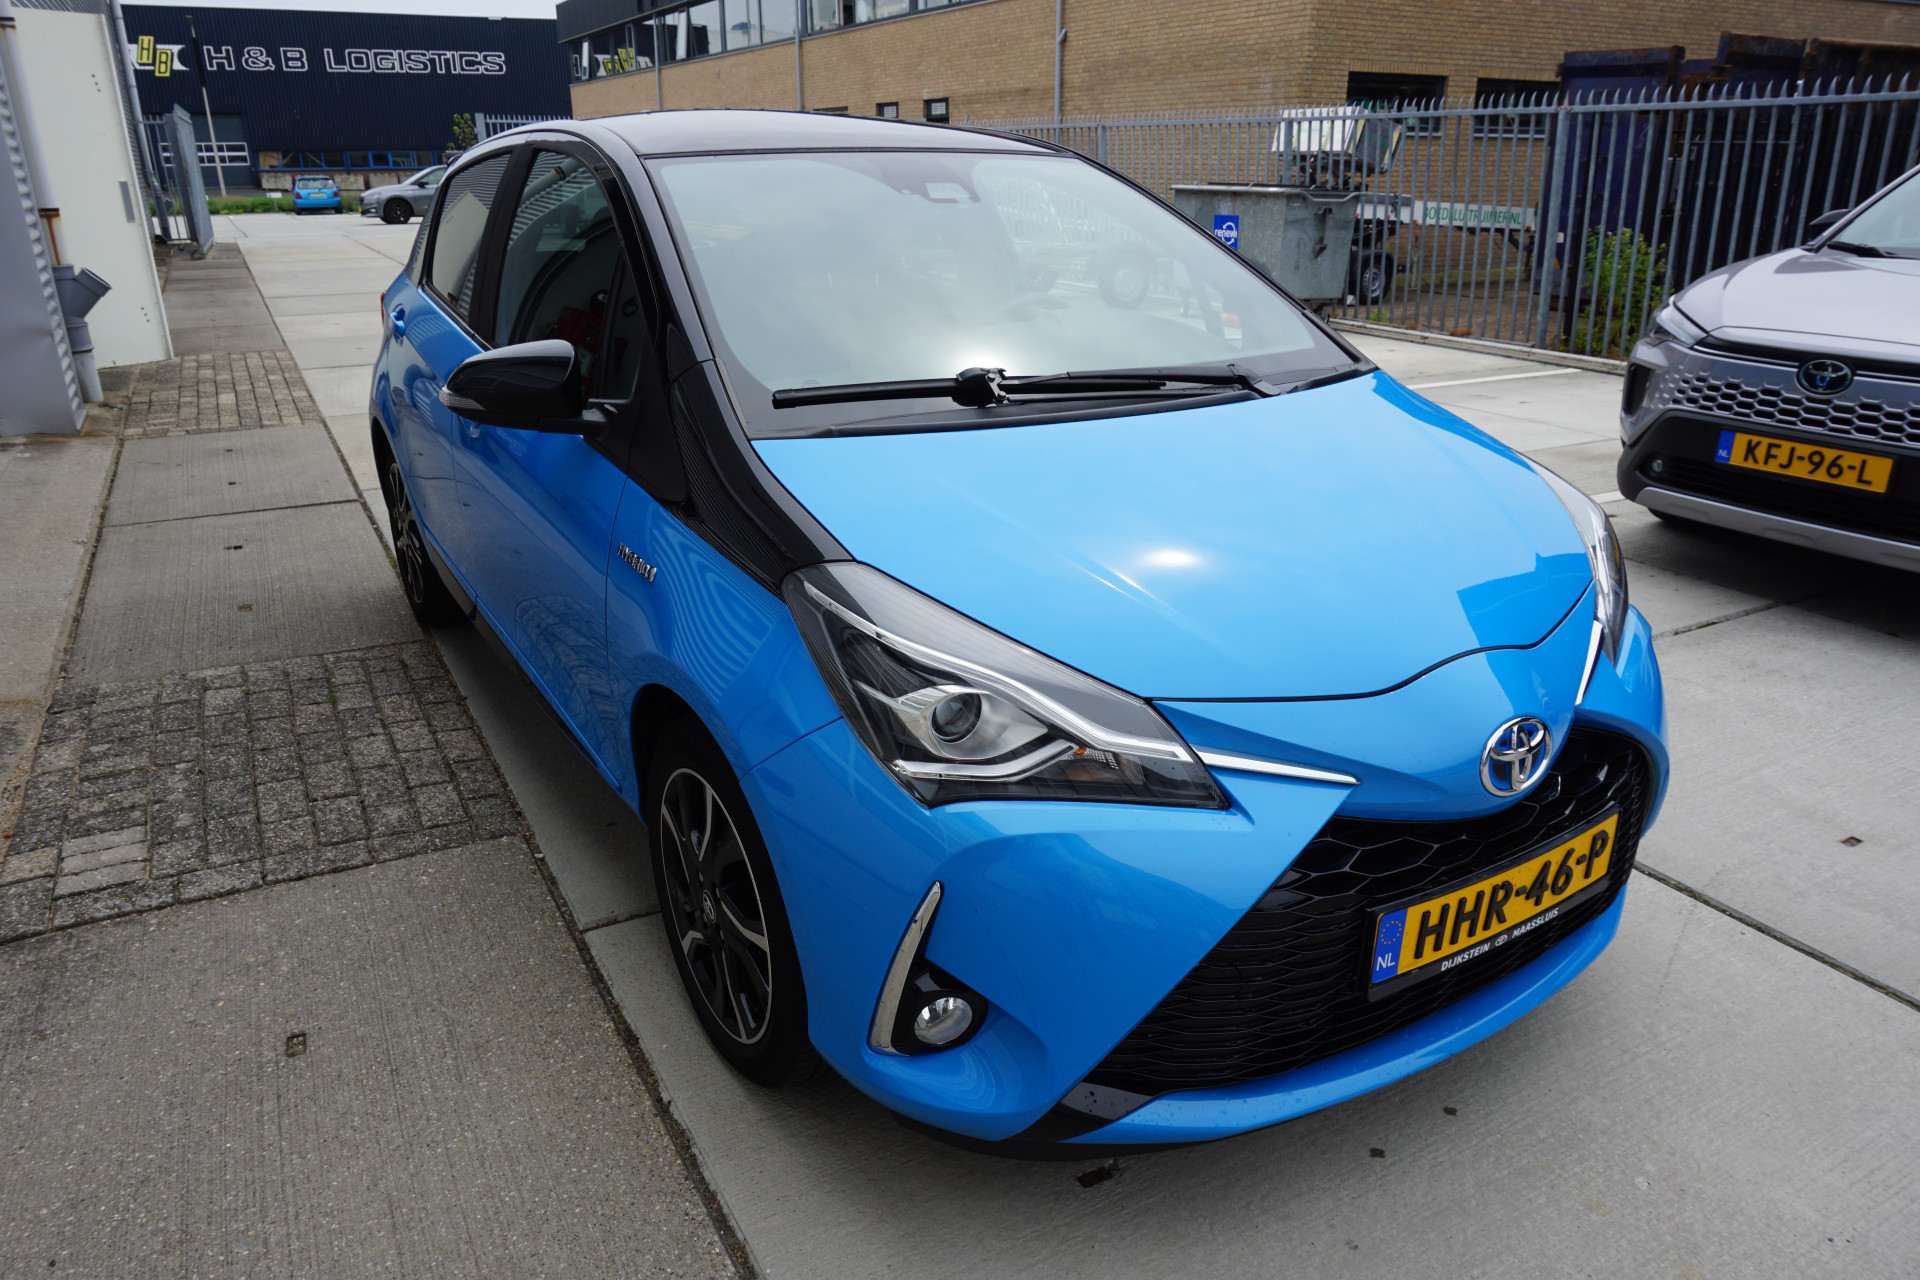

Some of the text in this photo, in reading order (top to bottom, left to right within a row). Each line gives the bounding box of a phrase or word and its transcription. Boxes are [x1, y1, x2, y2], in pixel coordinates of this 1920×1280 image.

[323, 48, 506, 75] LOGISTICS
[1718, 449, 1729, 458] NL
[1743, 439, 1873, 486] KFJ-96-L
[1413, 829, 1610, 960] HHR-46-P
[1440, 907, 1560, 972] DIJKSTEIN MAASSLUIS
[1376, 952, 1396, 972] NL
